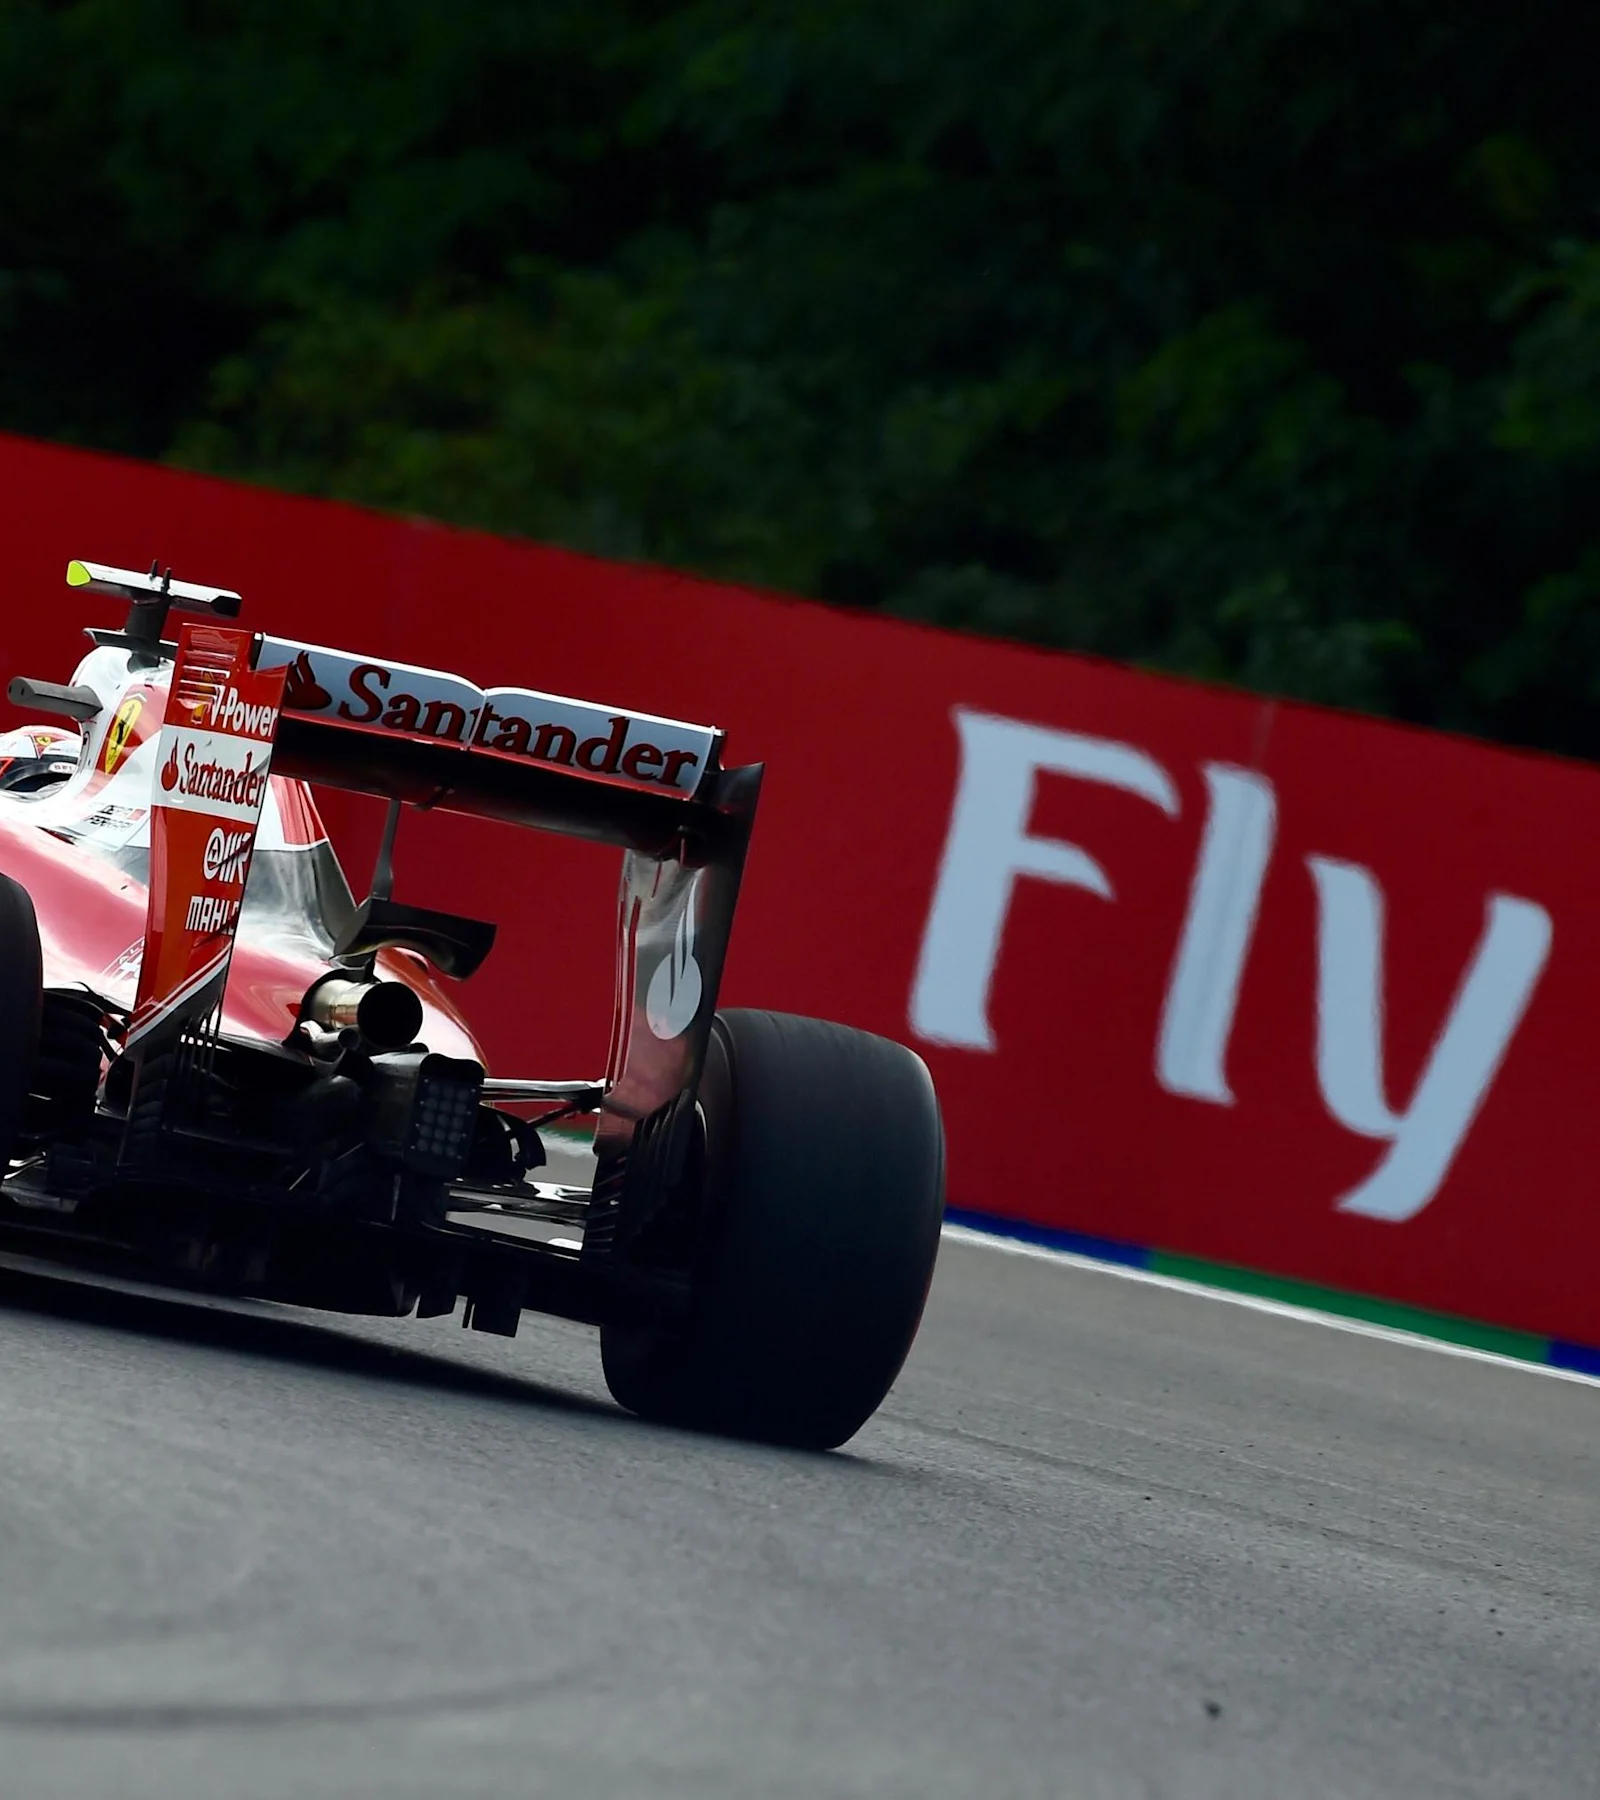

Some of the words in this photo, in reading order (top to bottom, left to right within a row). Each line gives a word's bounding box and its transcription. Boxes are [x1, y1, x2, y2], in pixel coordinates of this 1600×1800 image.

[210, 685, 279, 738] V-Power
[337, 664, 699, 788] Santander
[178, 743, 266, 809] Santander
[907, 703, 1554, 1223] Fly
